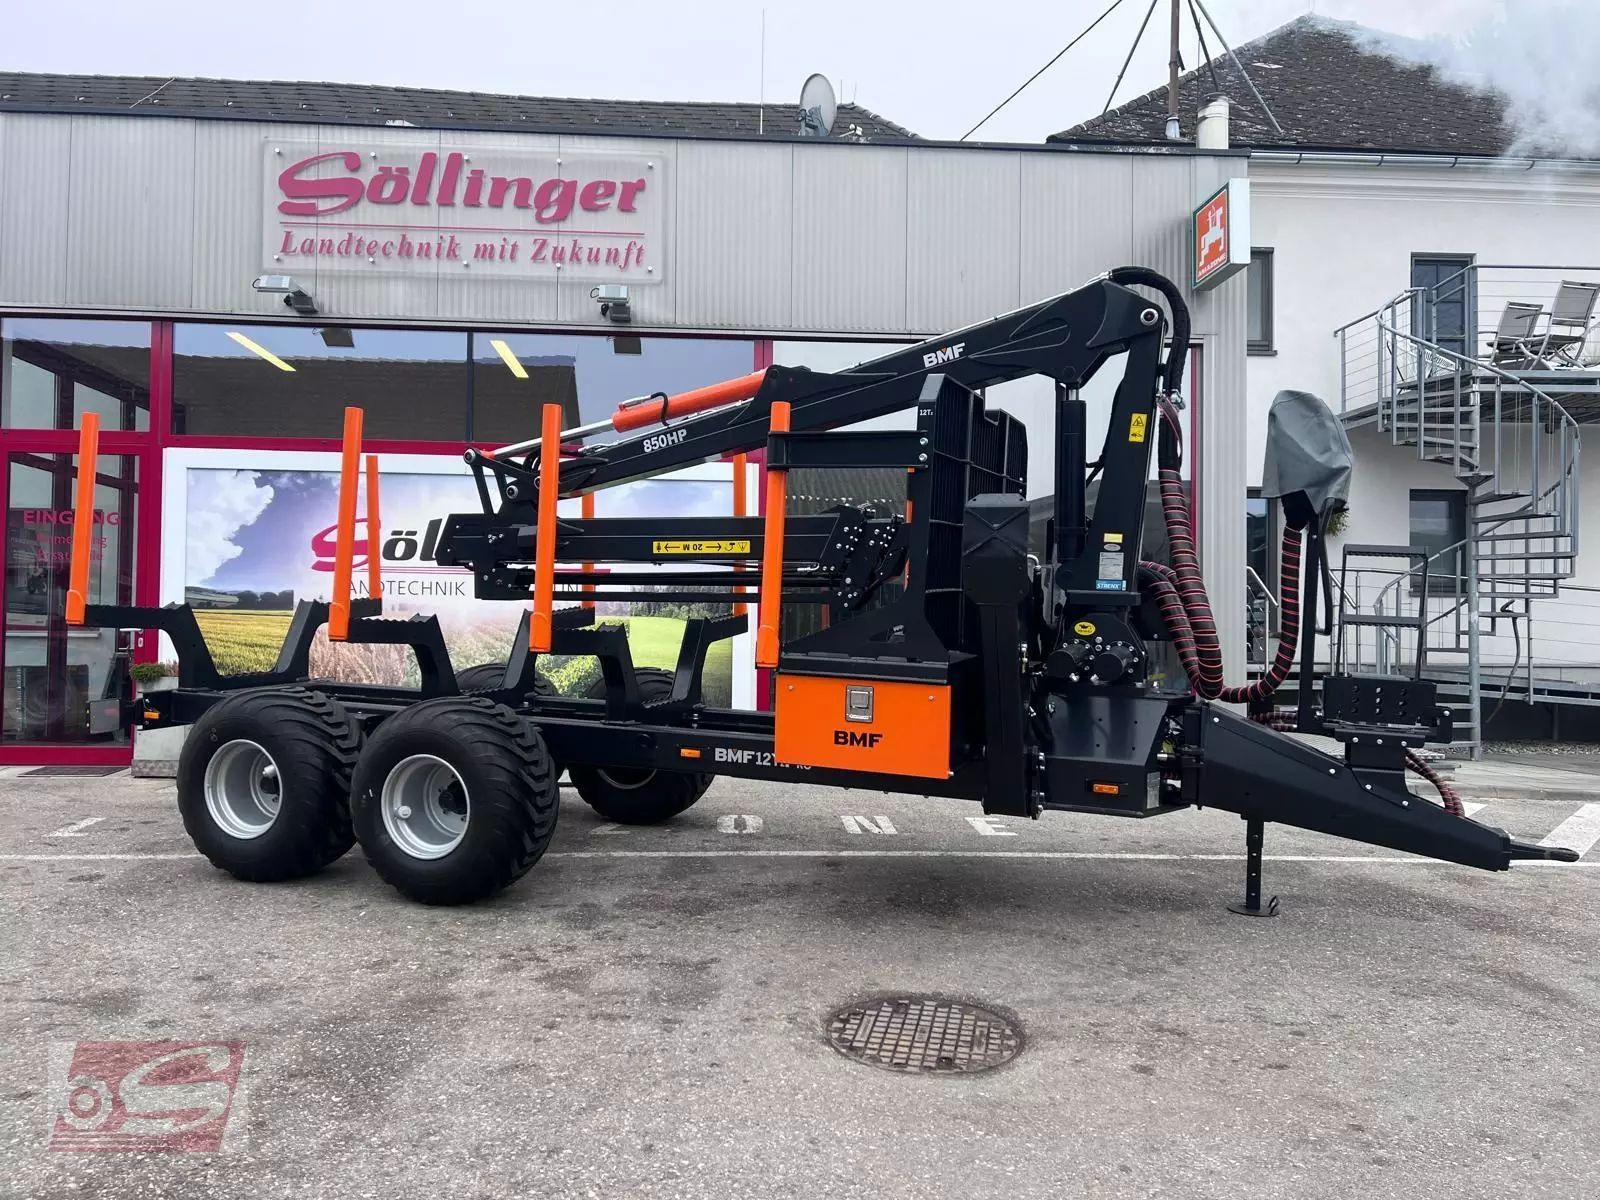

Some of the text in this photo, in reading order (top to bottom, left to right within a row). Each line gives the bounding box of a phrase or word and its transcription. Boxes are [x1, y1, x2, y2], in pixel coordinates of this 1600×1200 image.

[277, 151, 646, 224] Söllinger
[279, 230, 647, 270] Landtechnik mit Zukunft
[923, 342, 966, 368] BMF
[643, 428, 688, 453] 850HP
[23, 510, 120, 526] EINGNG
[834, 730, 883, 748] BMF
